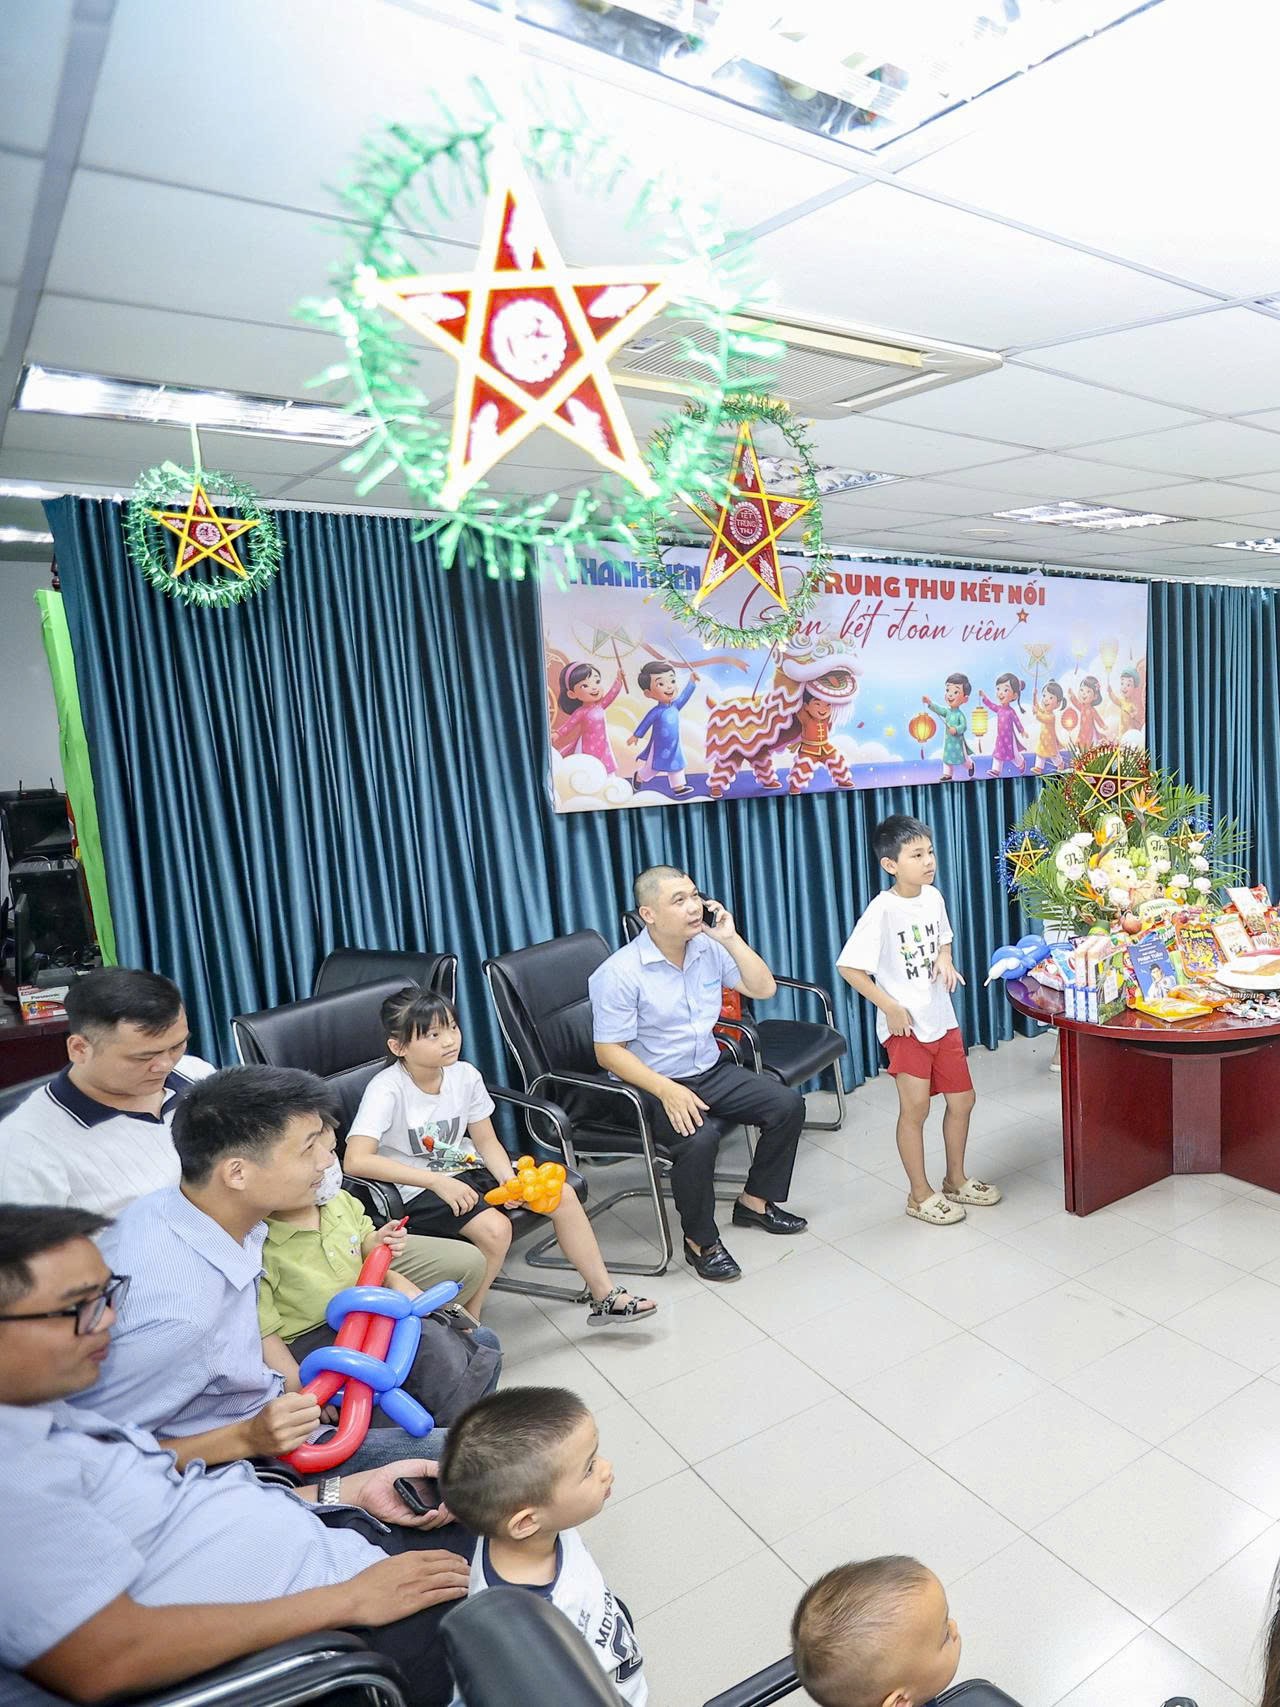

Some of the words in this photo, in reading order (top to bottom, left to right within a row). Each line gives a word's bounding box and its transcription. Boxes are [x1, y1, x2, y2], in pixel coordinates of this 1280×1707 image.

[905, 578, 955, 600] THU
[961, 576, 1004, 603] KẾT
[1008, 580, 1045, 606] NỐI
[840, 599, 890, 648] kết
[888, 601, 953, 641] đoàn
[962, 619, 1018, 642] viên
